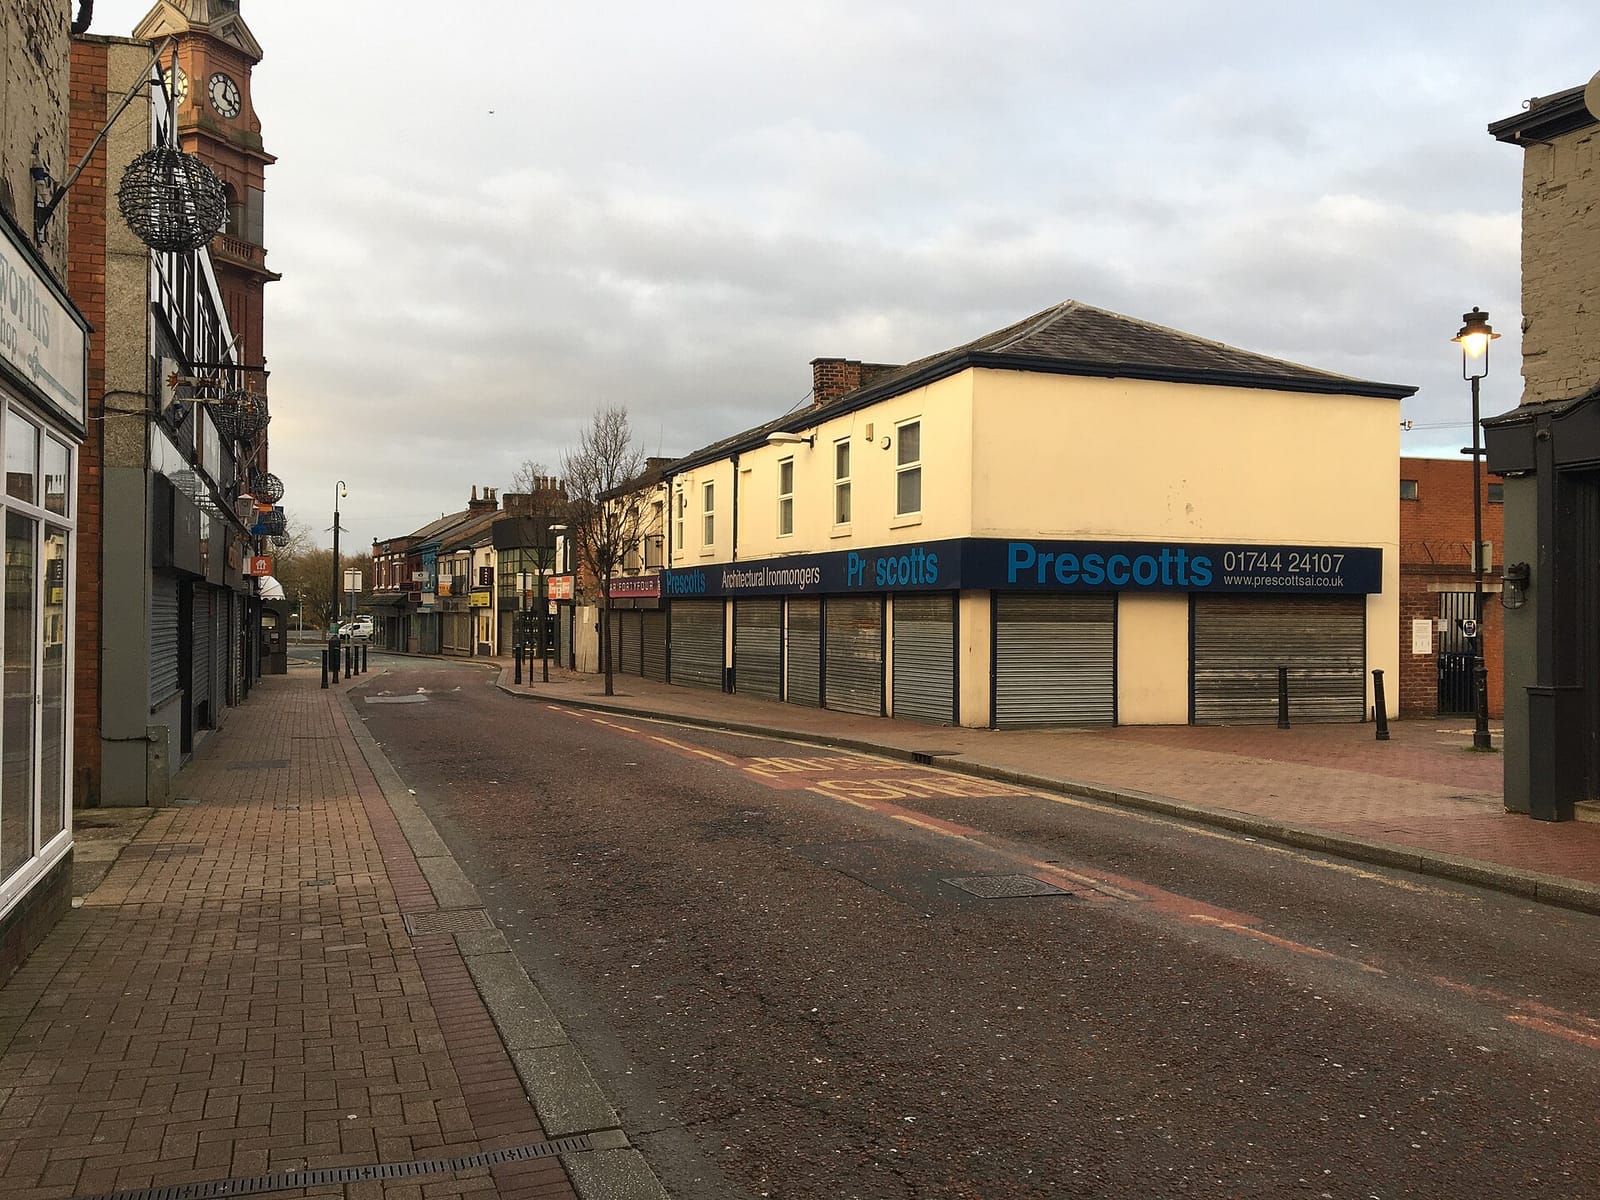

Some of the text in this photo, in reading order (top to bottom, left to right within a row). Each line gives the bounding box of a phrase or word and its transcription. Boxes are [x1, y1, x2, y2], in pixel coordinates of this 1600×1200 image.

[1007, 543, 1213, 587] Prescotts
[1223, 551, 1345, 574] 01744 24107
[666, 570, 707, 594] Prescotts
[721, 566, 820, 591] Architectural Ironmongers
[1223, 574, 1345, 588] www.prescottsai.co.uk
[816, 778, 1033, 800] BUS
